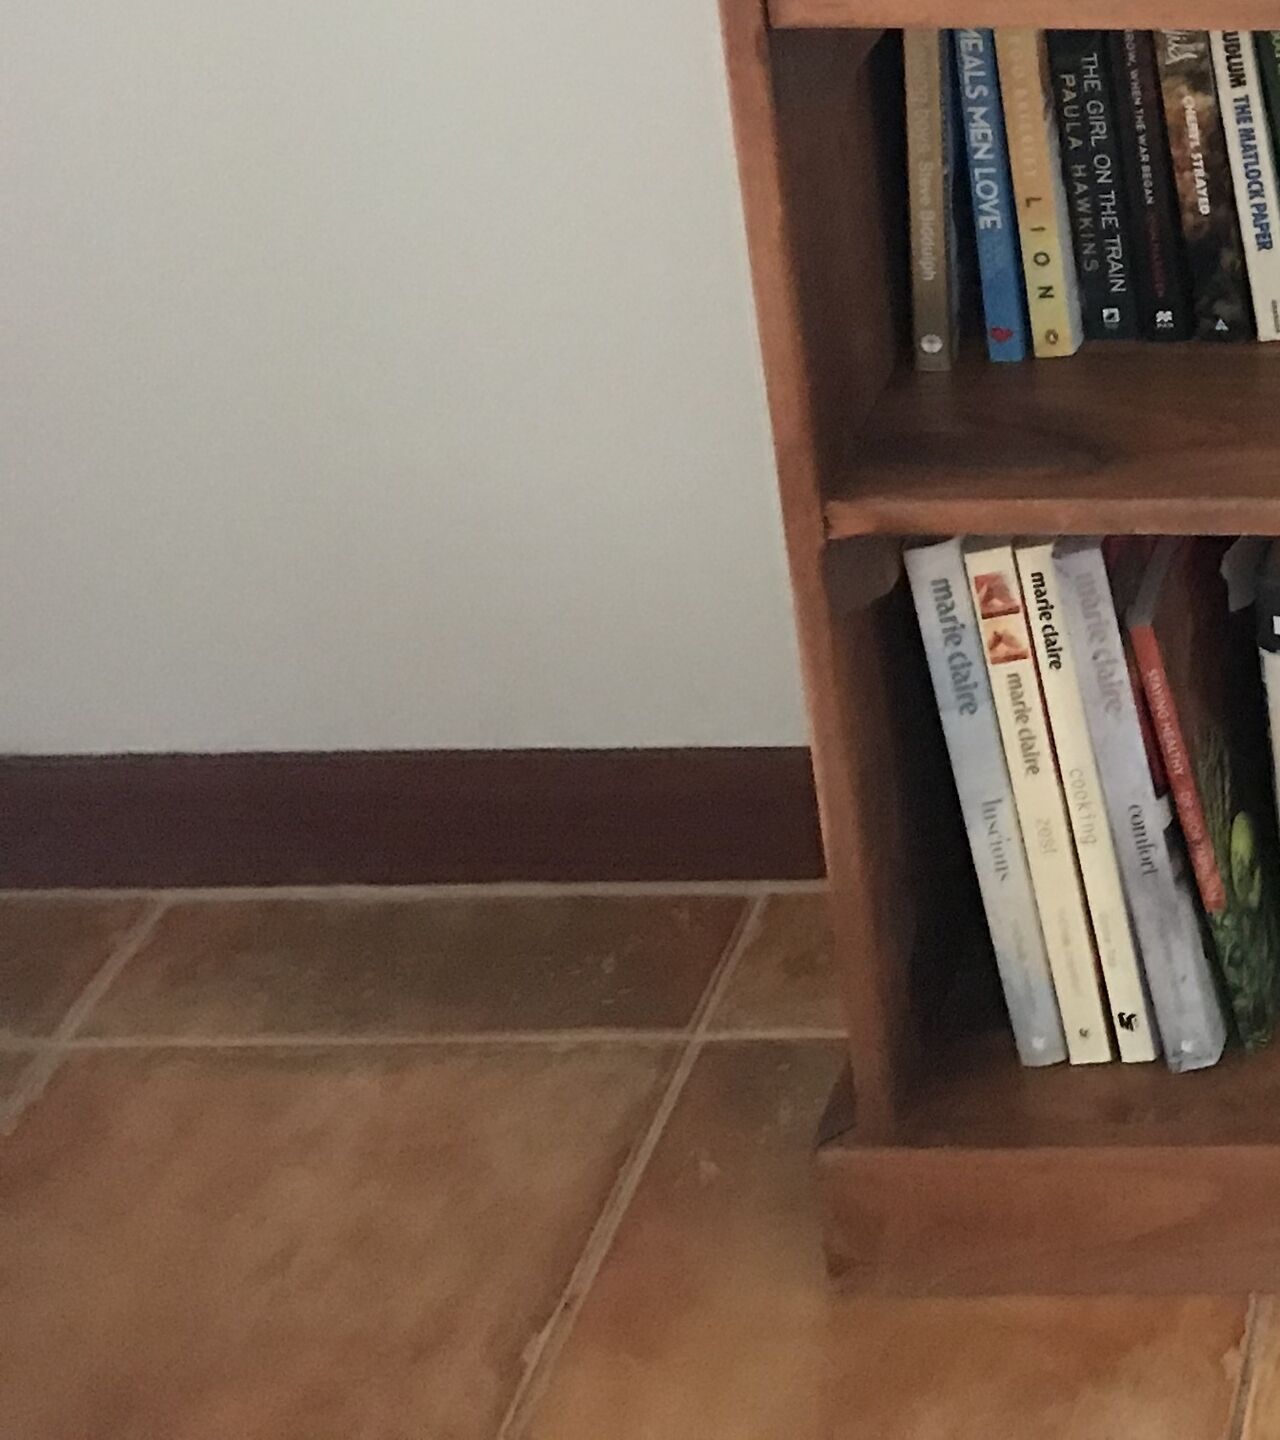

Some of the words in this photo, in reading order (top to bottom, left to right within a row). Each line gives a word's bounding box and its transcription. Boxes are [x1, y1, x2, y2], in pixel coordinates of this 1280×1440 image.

[1080, 52, 1101, 90] THE
[1164, 30, 1199, 64] ild
[1221, 30, 1247, 88] UDLUM
[1059, 73, 1081, 150] PAULA
[1129, 69, 1143, 106] WHEN
[1233, 93, 1253, 124] THE
[967, 106, 995, 160] MEN
[1085, 96, 1107, 148] GIRL
[1133, 107, 1147, 131] THE
[1183, 95, 1205, 150] CHERYL
[1091, 153, 1112, 184] ON
[1136, 133, 1151, 162] WAR
[1237, 124, 1265, 200] MATLOCK
[917, 161, 934, 208] Steve
[974, 165, 1001, 231] LOVE
[1098, 190, 1120, 231] THE
[1140, 163, 1156, 206] BEGAN
[1190, 154, 1212, 216] STRAYED
[1068, 164, 1100, 273] HAWKINS
[1250, 201, 1274, 253] PAPER
[1024, 195, 1056, 300] LION
[1103, 233, 1127, 294] TRAIN
[930, 576, 964, 646] marie
[1029, 569, 1055, 622] marie
[1074, 572, 1110, 644] marie
[1041, 618, 1064, 672] claire
[944, 641, 979, 717] claire
[1005, 671, 1032, 724] marie
[1088, 640, 1124, 717] claire
[1016, 721, 1042, 778] claire
[1146, 668, 1169, 718] STAYING
[1158, 715, 1186, 778] HEALTHY
[1068, 767, 1100, 847] cooking
[1127, 803, 1160, 880] comfort
